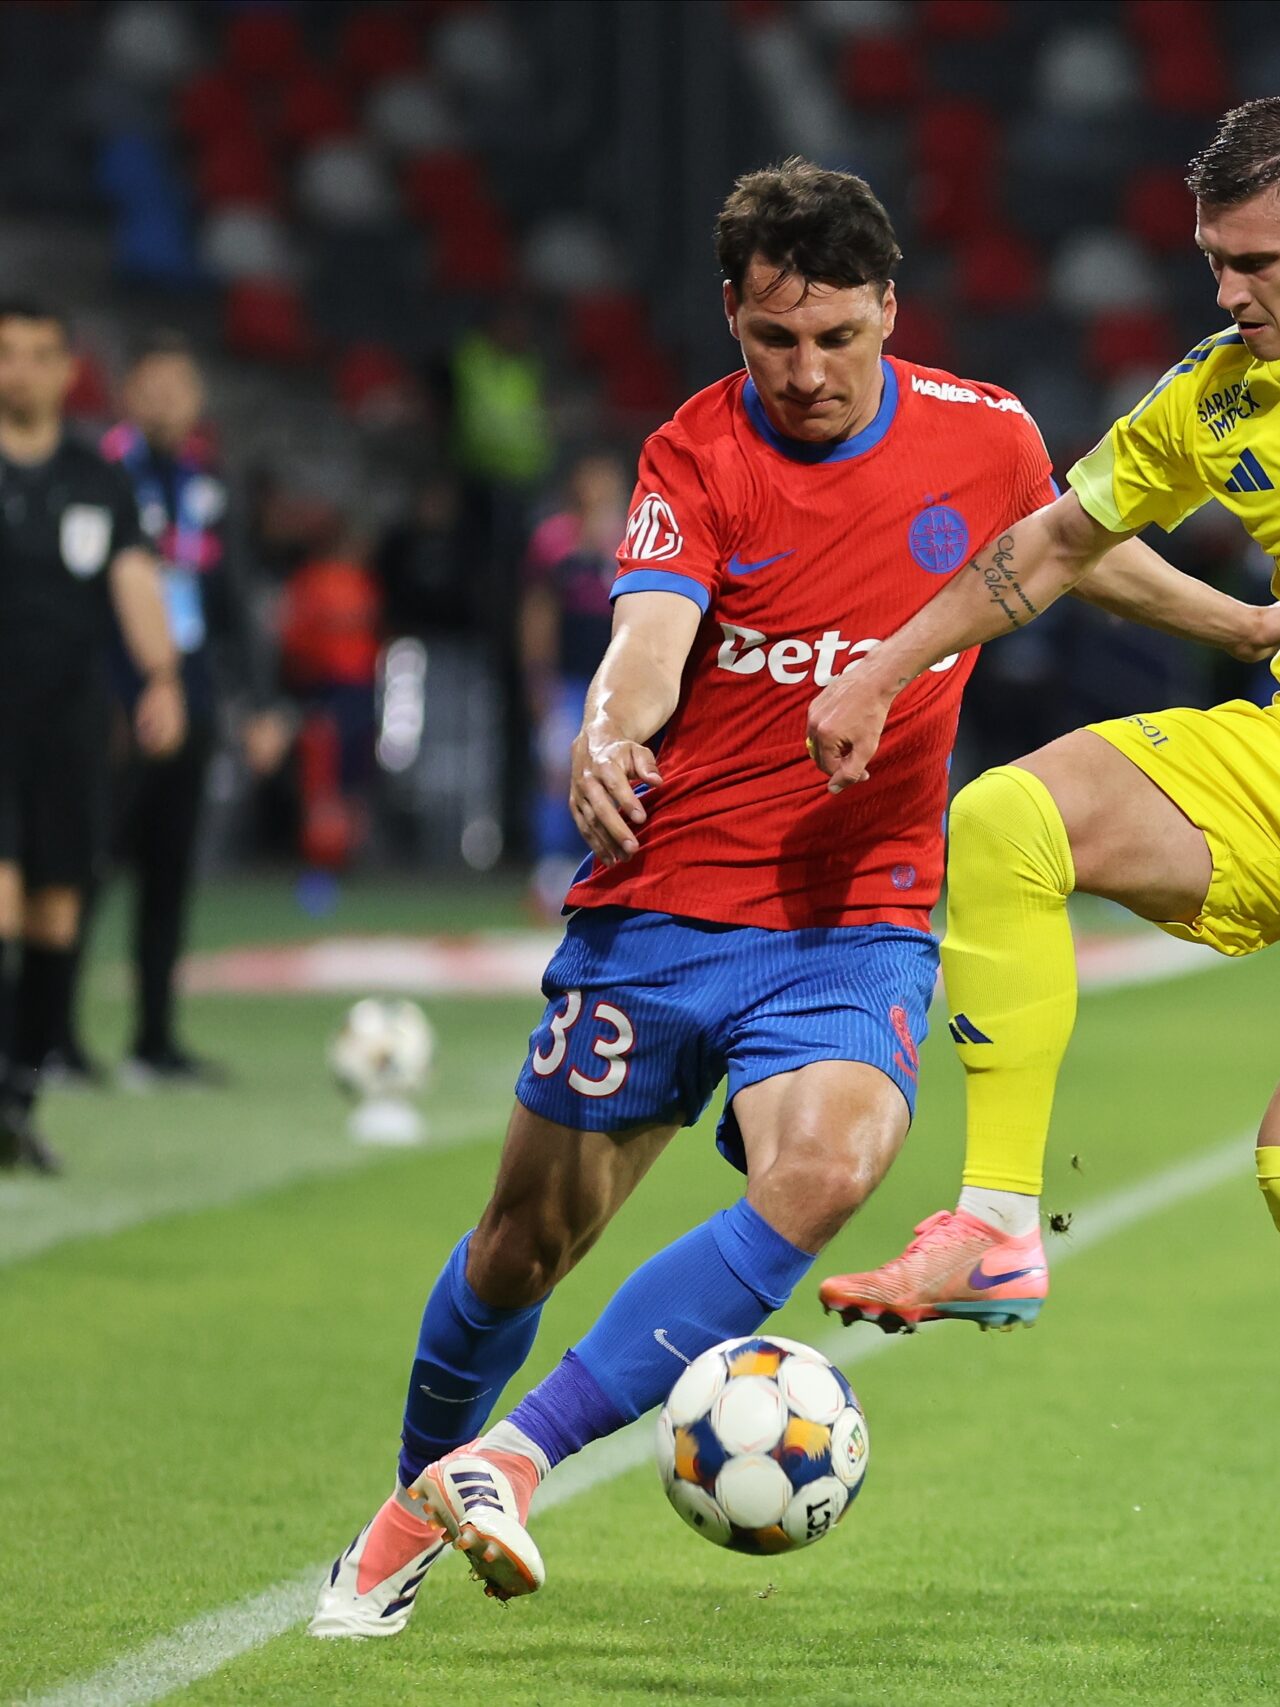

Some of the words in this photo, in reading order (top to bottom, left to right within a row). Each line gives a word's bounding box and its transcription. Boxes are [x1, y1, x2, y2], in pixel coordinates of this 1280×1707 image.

[1208, 389, 1261, 442] IMPEX
[626, 496, 678, 560] MG
[532, 987, 637, 1098] 33
